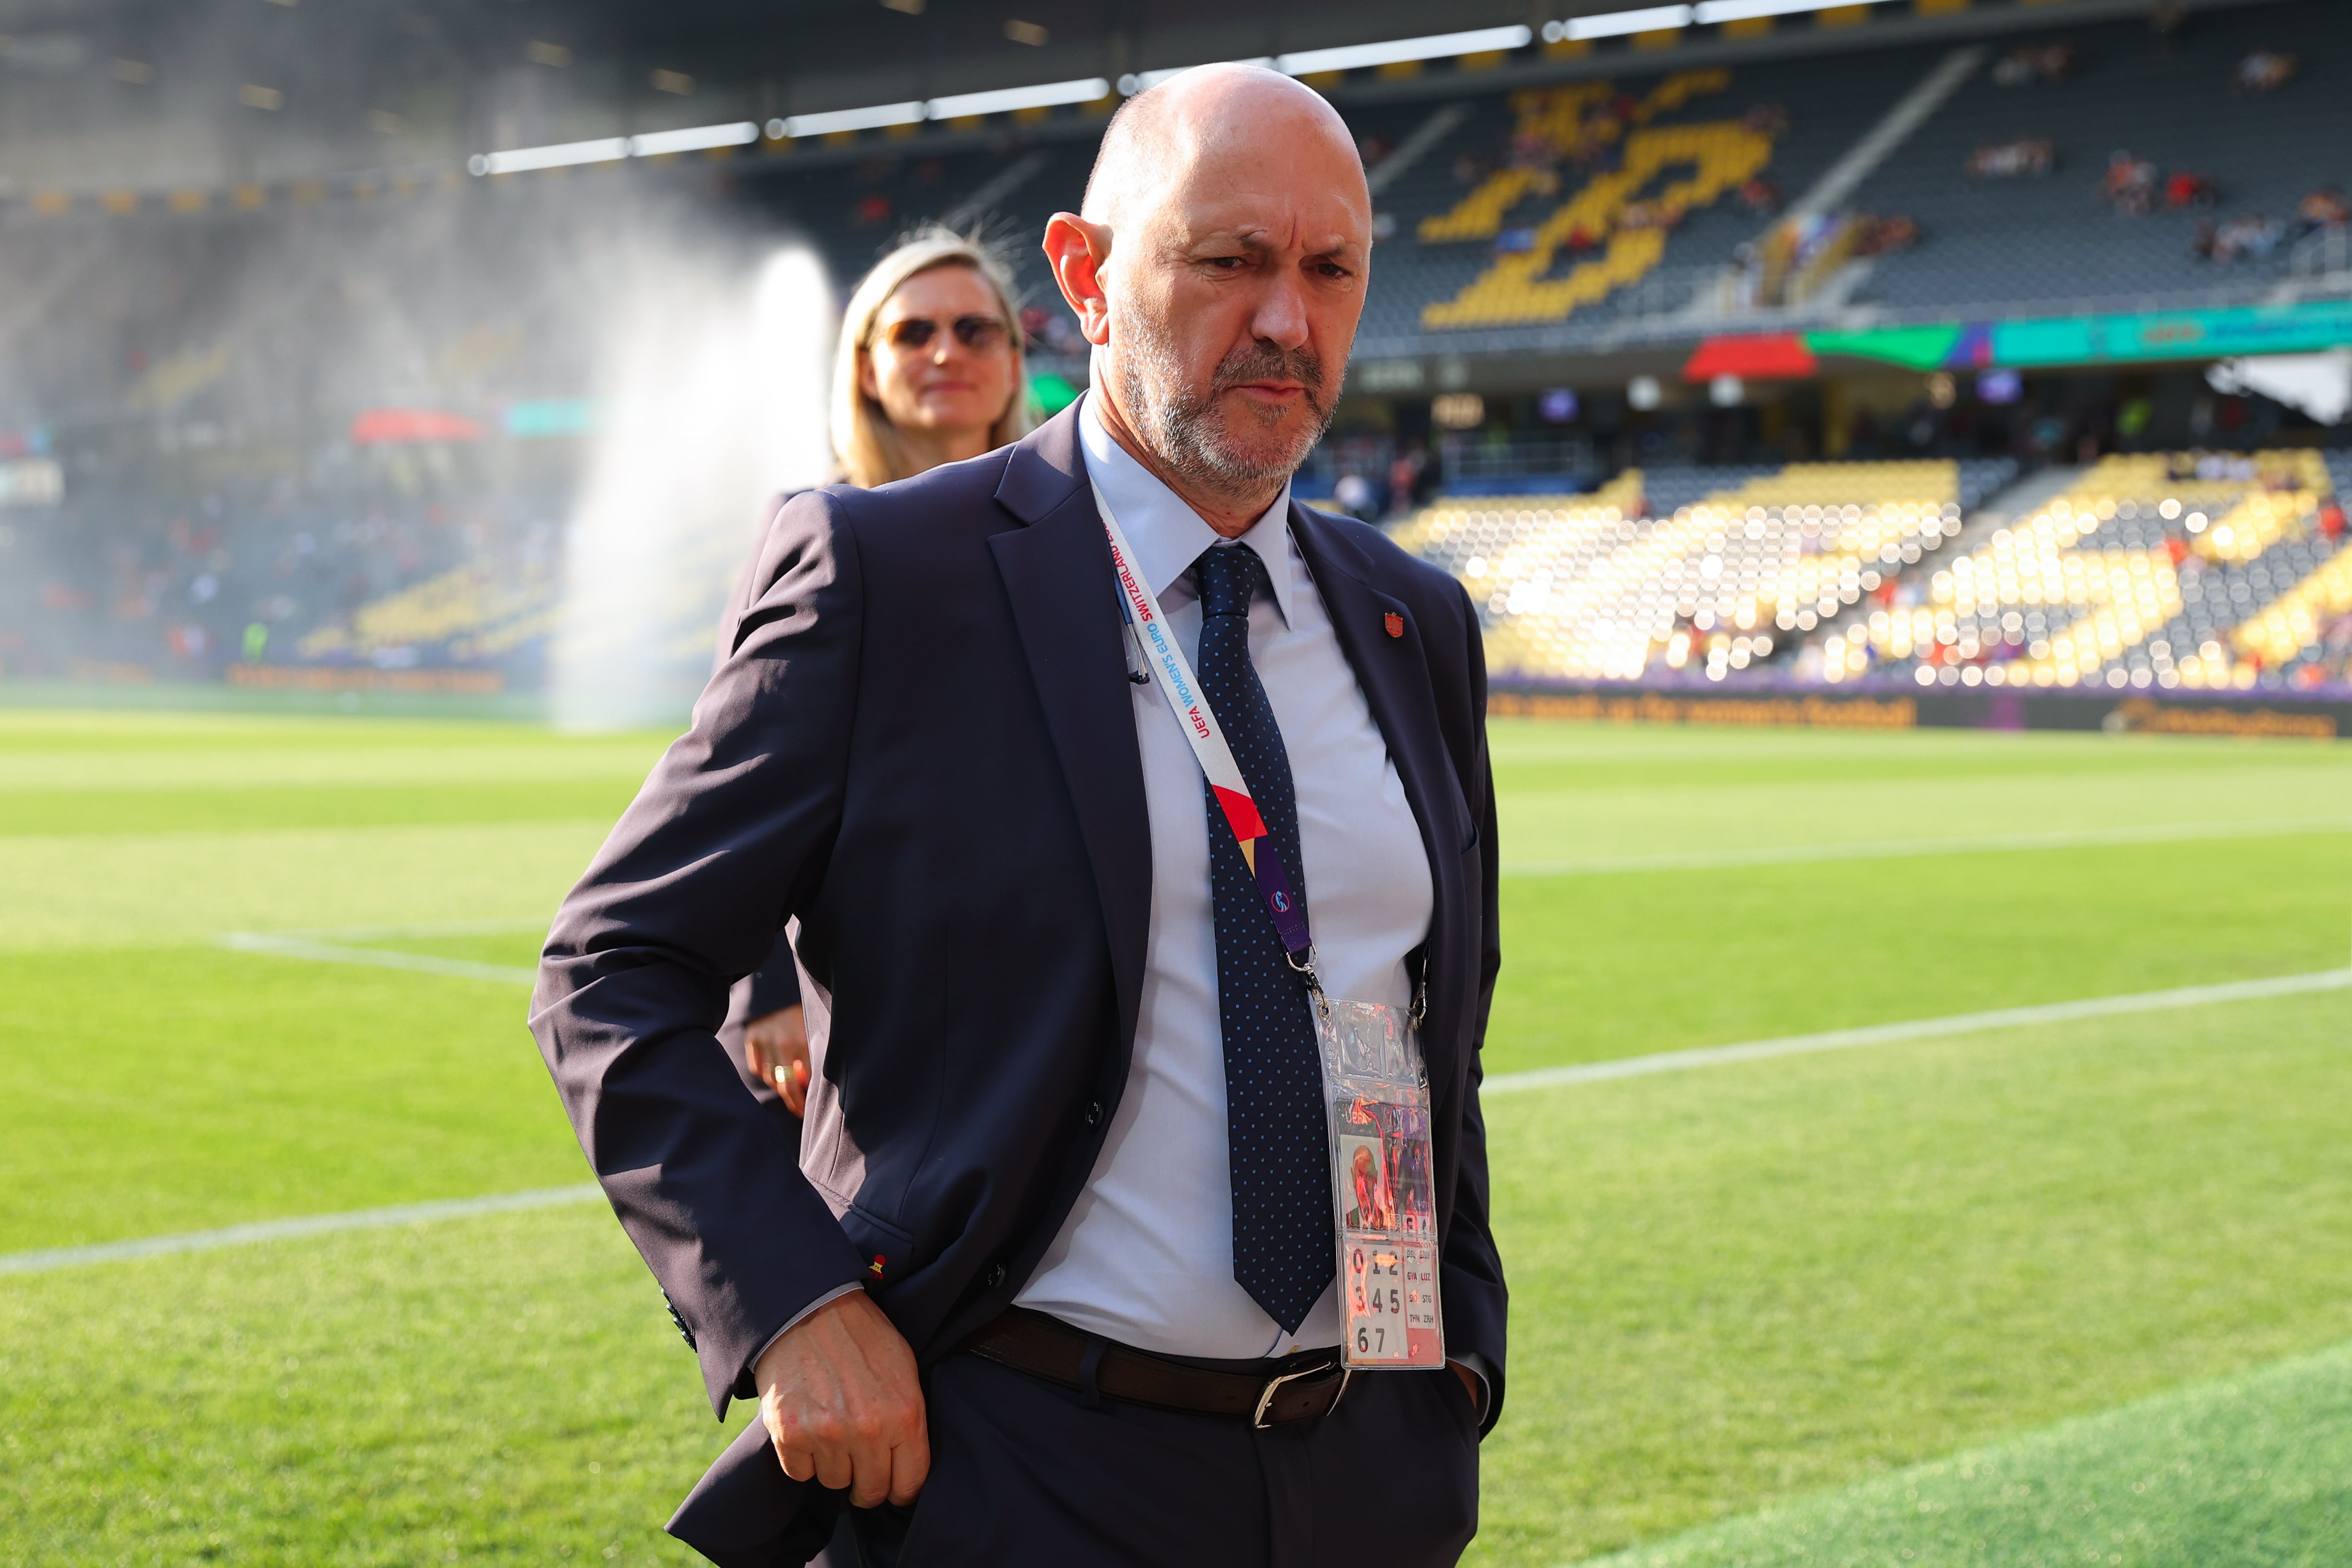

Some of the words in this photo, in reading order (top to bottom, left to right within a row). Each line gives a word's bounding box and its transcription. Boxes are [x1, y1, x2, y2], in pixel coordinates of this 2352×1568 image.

[1111, 545, 1153, 622] SWITZERLAND
[1147, 623, 1168, 654] EURO
[1162, 654, 1194, 708] WOMEN'S
[1188, 705, 1210, 739] UEFA
[1353, 1248, 1363, 1274] 0
[1372, 1249, 1380, 1275] 1
[1389, 1251, 1398, 1276] 2
[1407, 1272, 1417, 1280] GVA
[1420, 1273, 1431, 1281] LUZ
[1355, 1286, 1365, 1312] 3
[1372, 1288, 1383, 1313] 4
[1390, 1289, 1400, 1314] 5
[1422, 1295, 1432, 1303] STG
[1409, 1314, 1420, 1323] THN
[1423, 1315, 1434, 1323] ZRH
[1357, 1327, 1368, 1353] 6
[1375, 1328, 1385, 1353] 7
